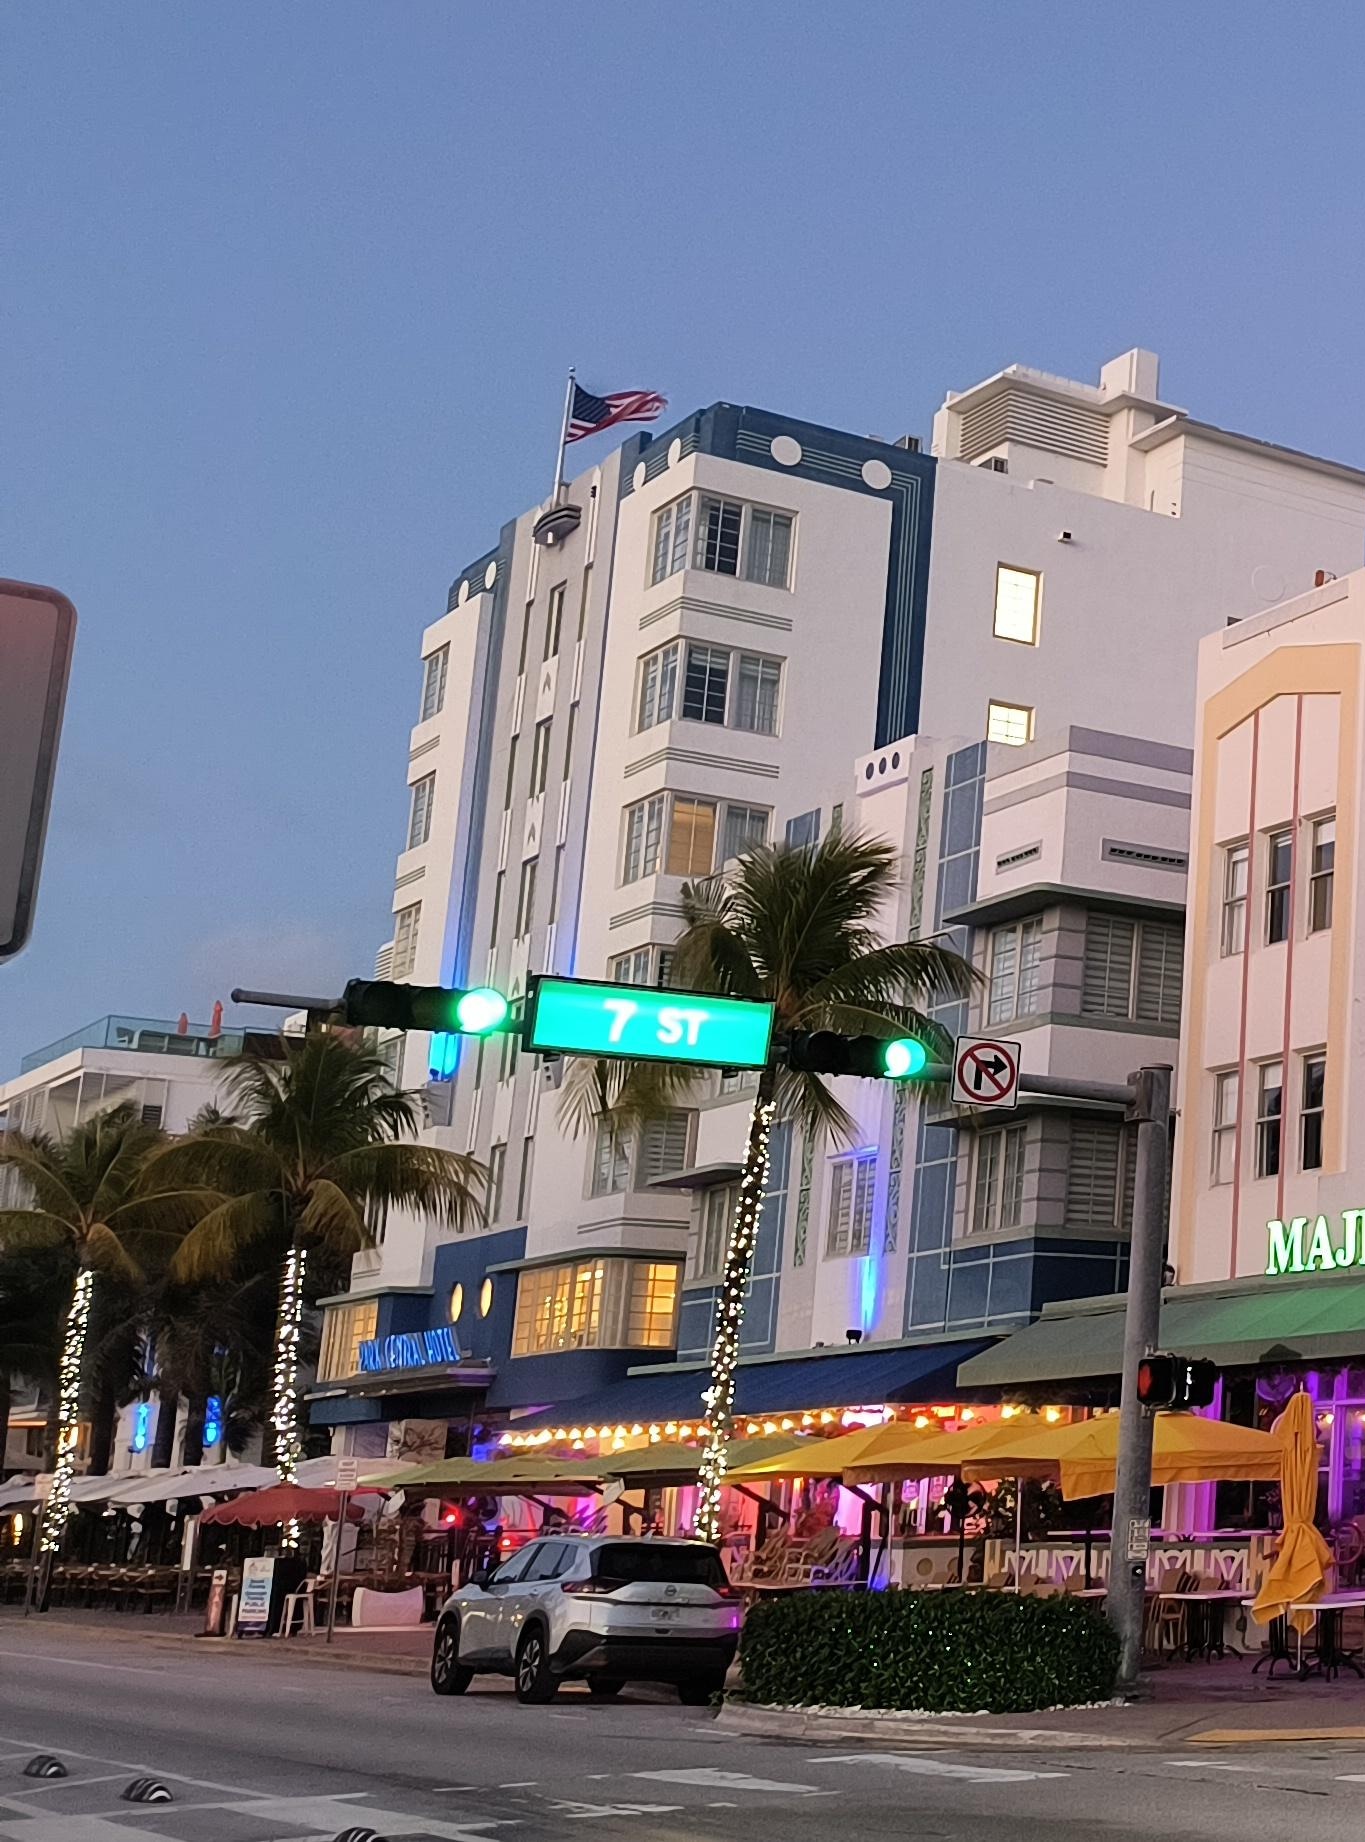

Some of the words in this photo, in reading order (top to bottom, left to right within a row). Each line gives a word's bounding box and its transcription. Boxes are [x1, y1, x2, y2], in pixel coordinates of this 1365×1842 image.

[604, 999, 638, 1043] 7
[657, 1008, 709, 1046] ST
[423, 1327, 460, 1363] HOTEL
